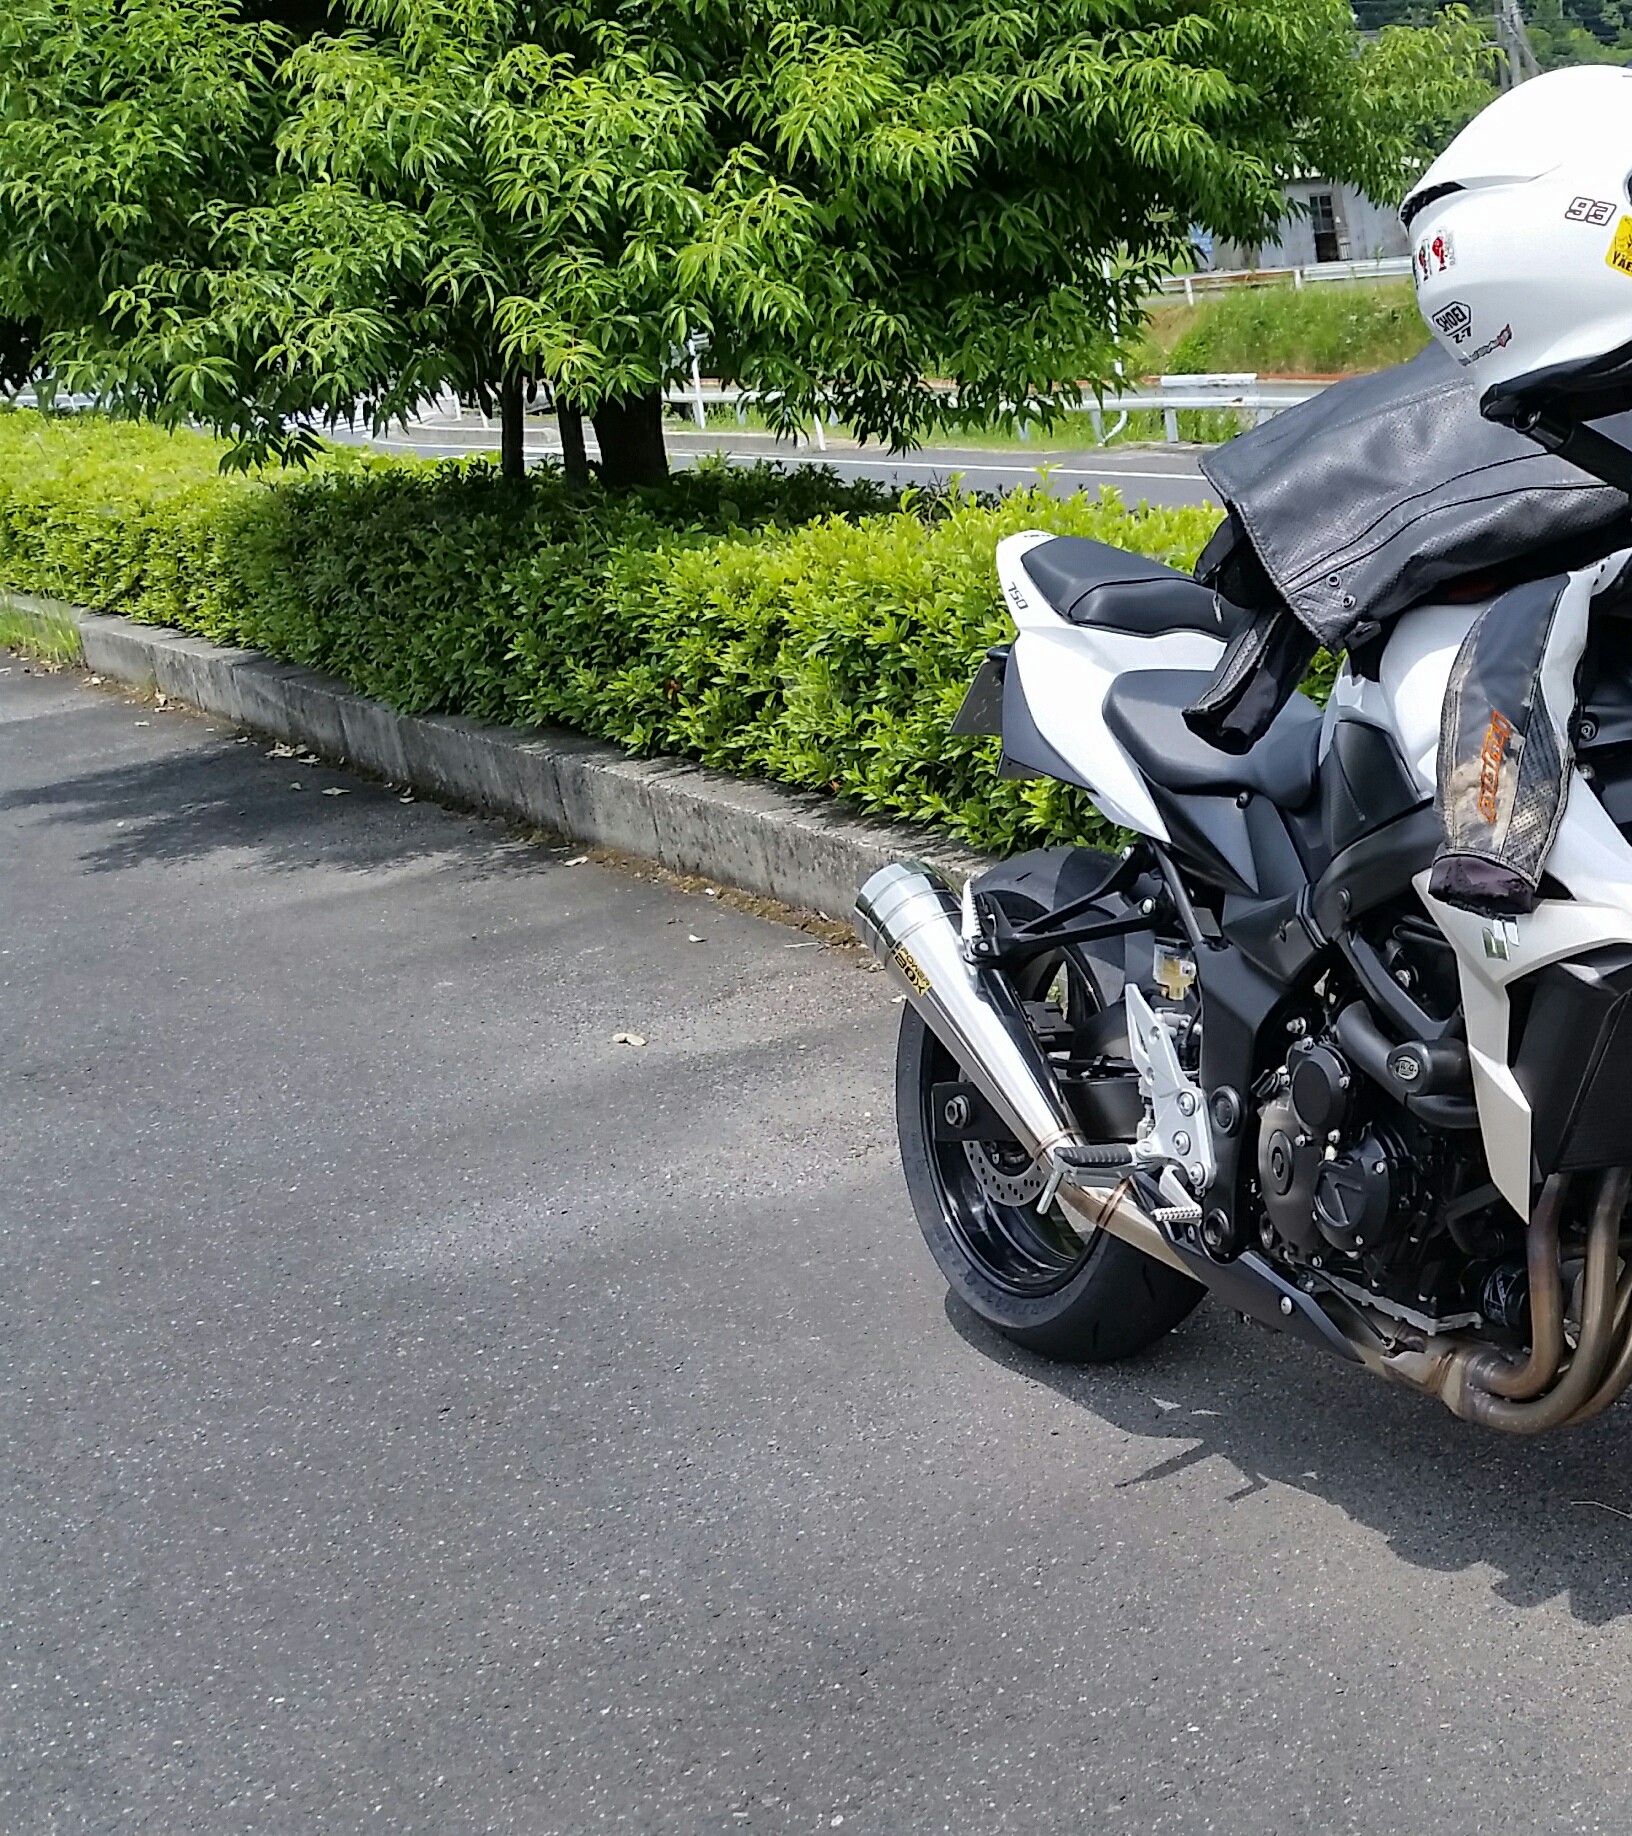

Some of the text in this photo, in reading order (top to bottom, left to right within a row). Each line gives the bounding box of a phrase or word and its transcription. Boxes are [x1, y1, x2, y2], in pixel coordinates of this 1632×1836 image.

[1564, 196, 1617, 226] 93
[1435, 305, 1468, 333] SHOEI
[895, 952, 926, 995] BOX
